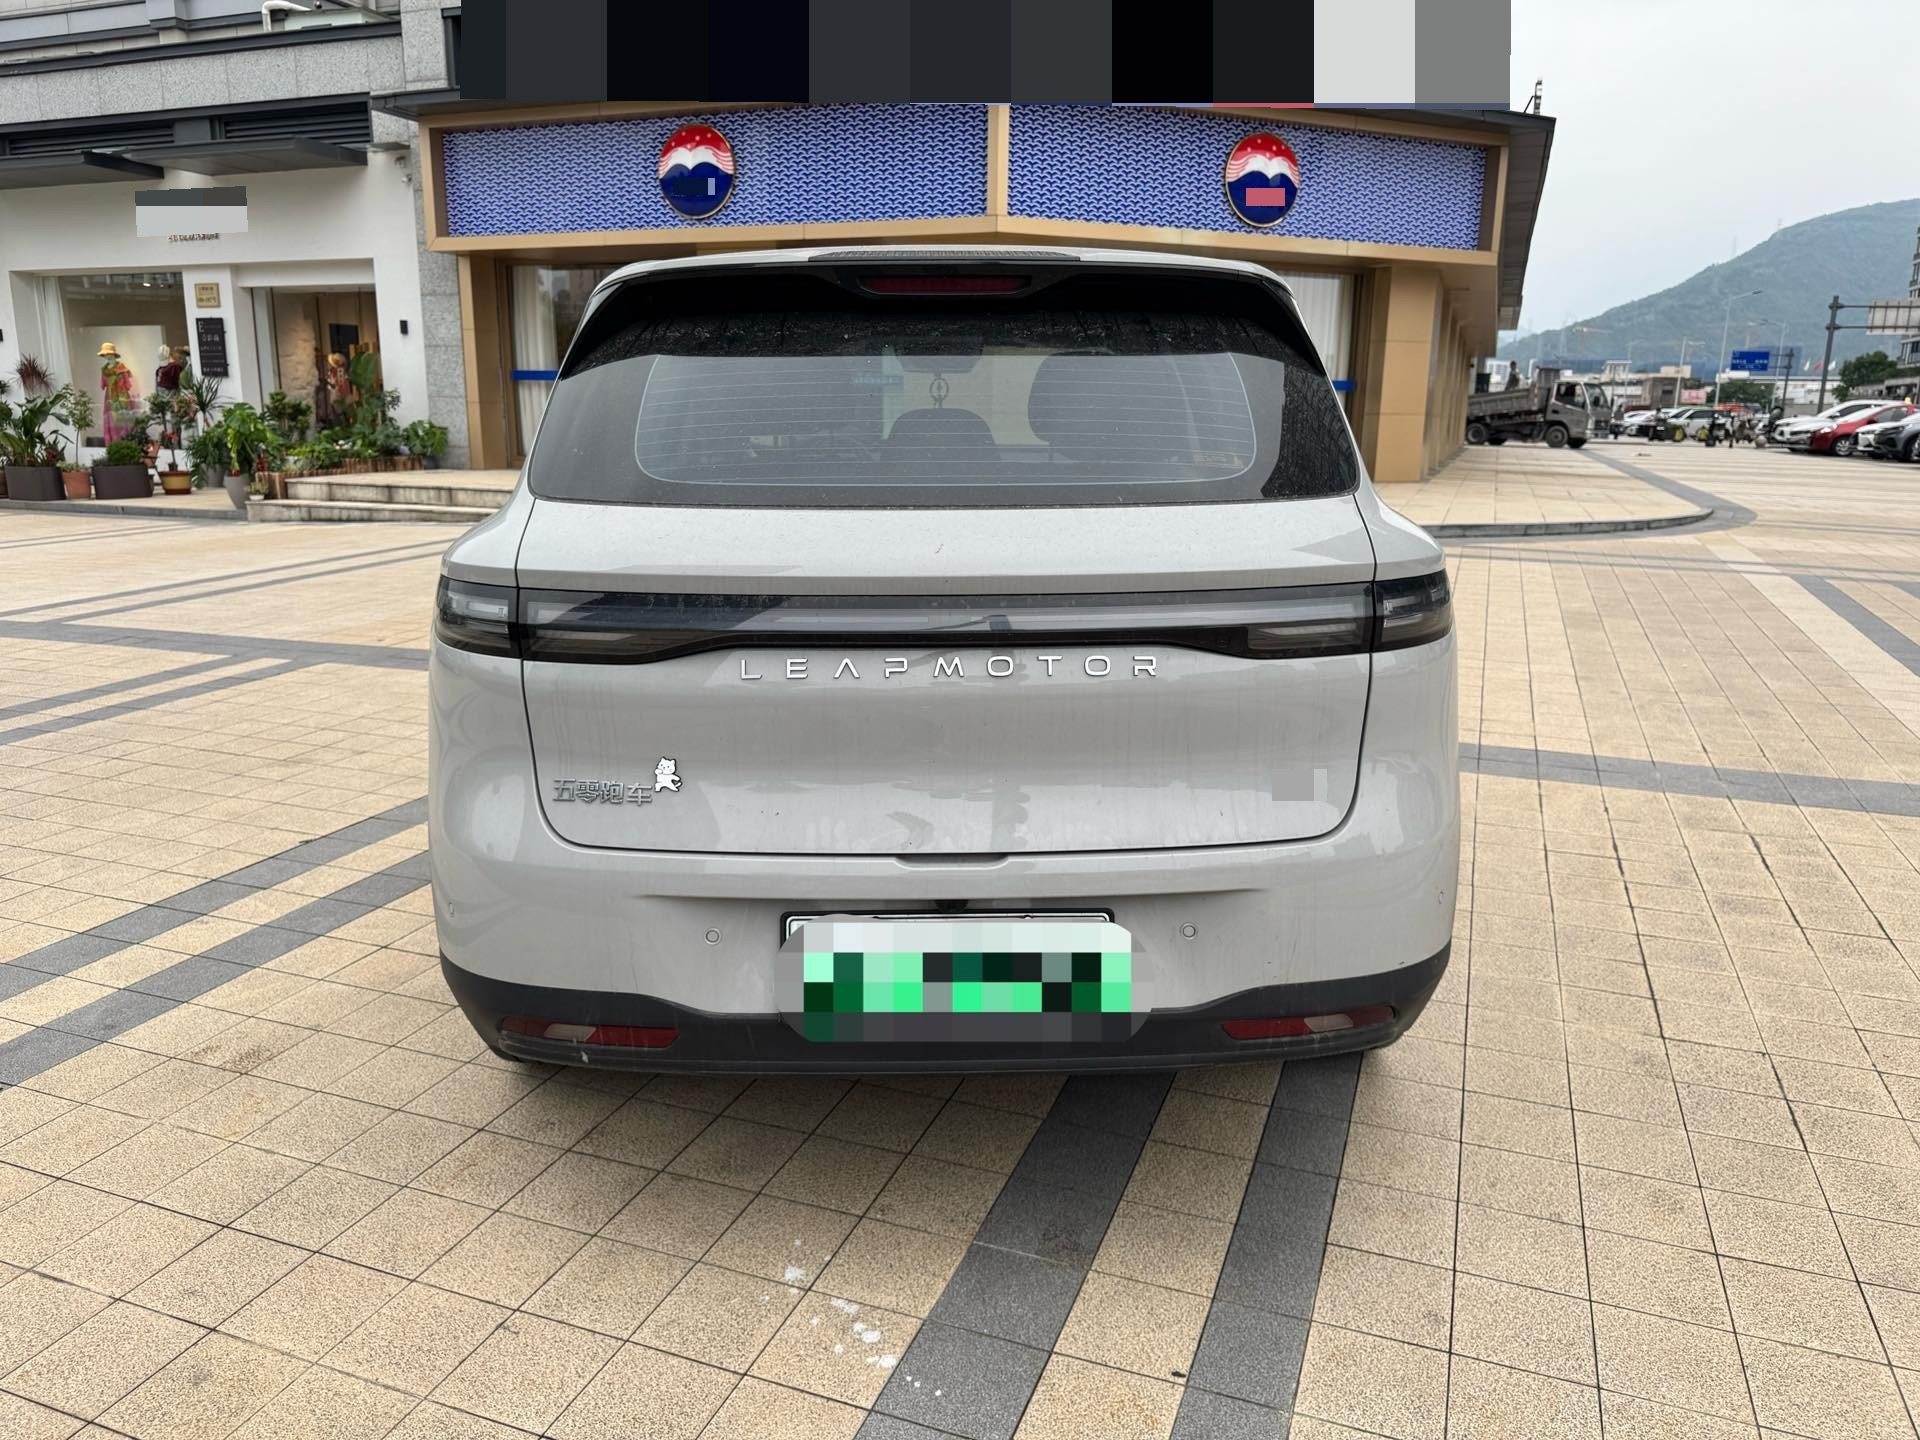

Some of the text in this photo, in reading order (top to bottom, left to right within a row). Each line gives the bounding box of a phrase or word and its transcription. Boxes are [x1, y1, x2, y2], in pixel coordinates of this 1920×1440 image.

[740, 655, 1158, 679] LEAPMOTOR
[552, 777, 654, 806] 五零跑车
